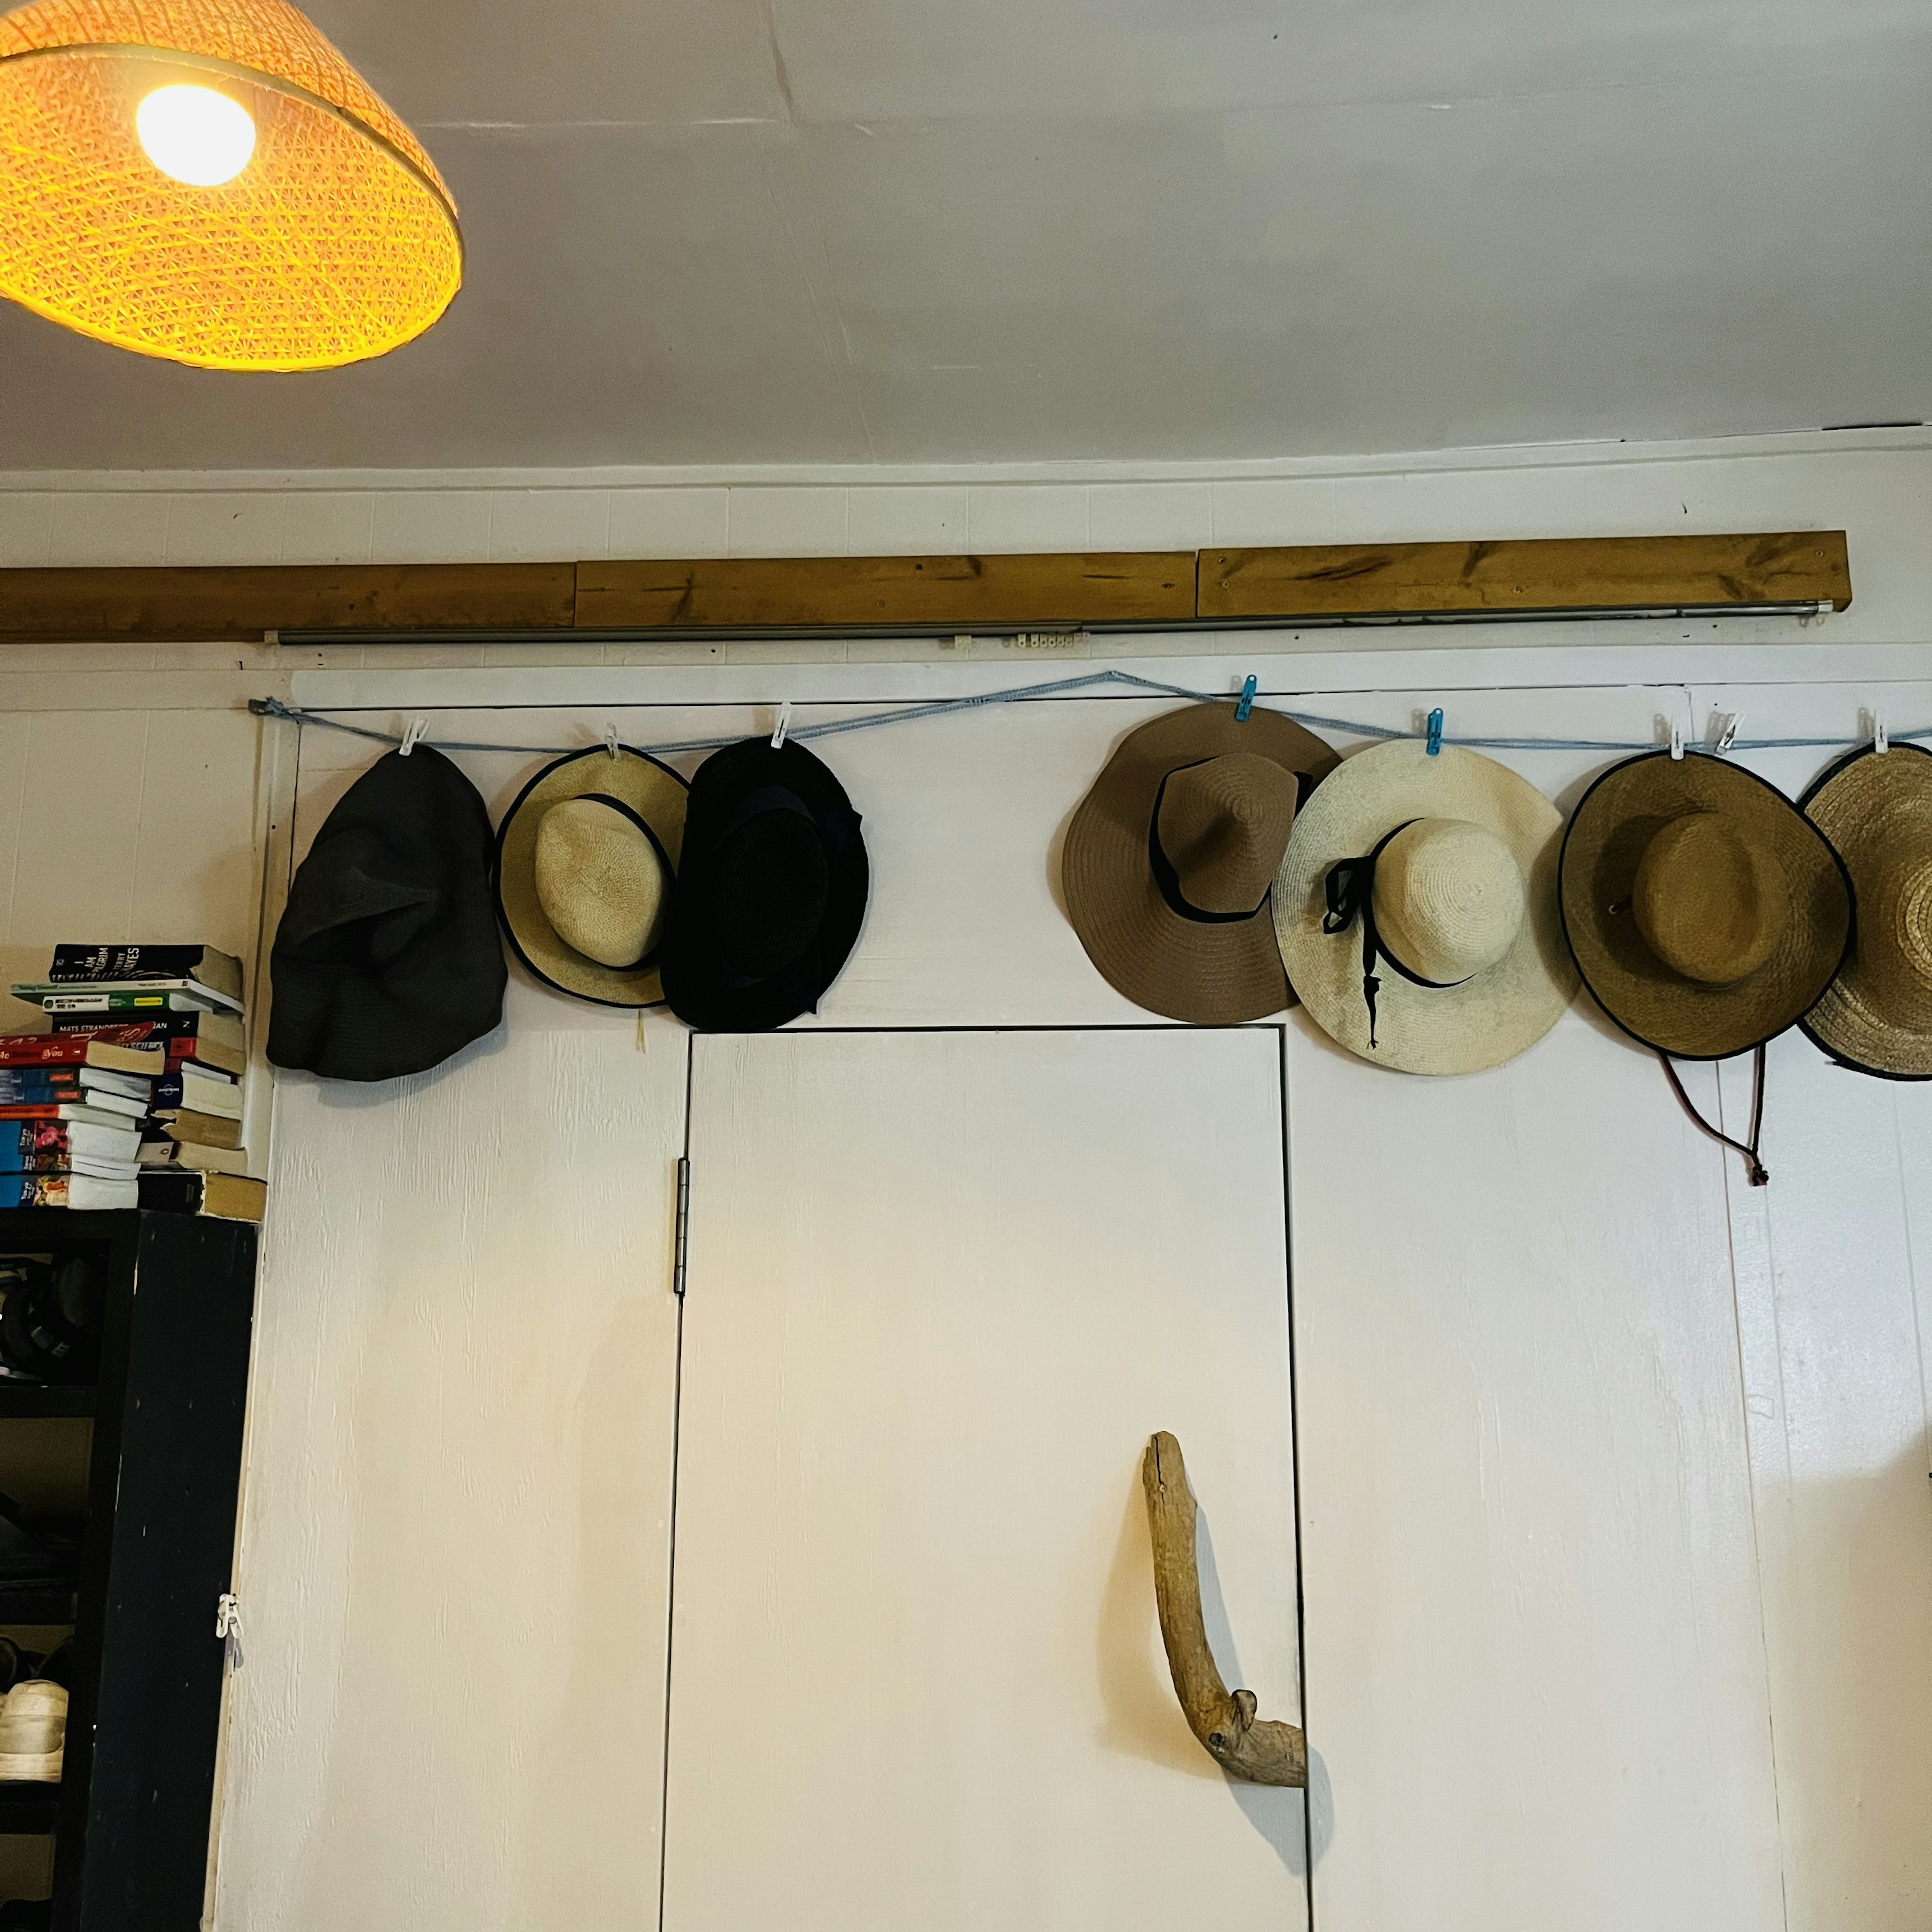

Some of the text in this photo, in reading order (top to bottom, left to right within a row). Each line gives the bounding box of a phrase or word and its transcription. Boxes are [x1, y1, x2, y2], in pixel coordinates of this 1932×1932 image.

[85, 956, 97, 968] AM
[92, 947, 109, 973] PILGRIM
[112, 952, 126, 970] TERRY
[122, 947, 139, 972] HAYES
